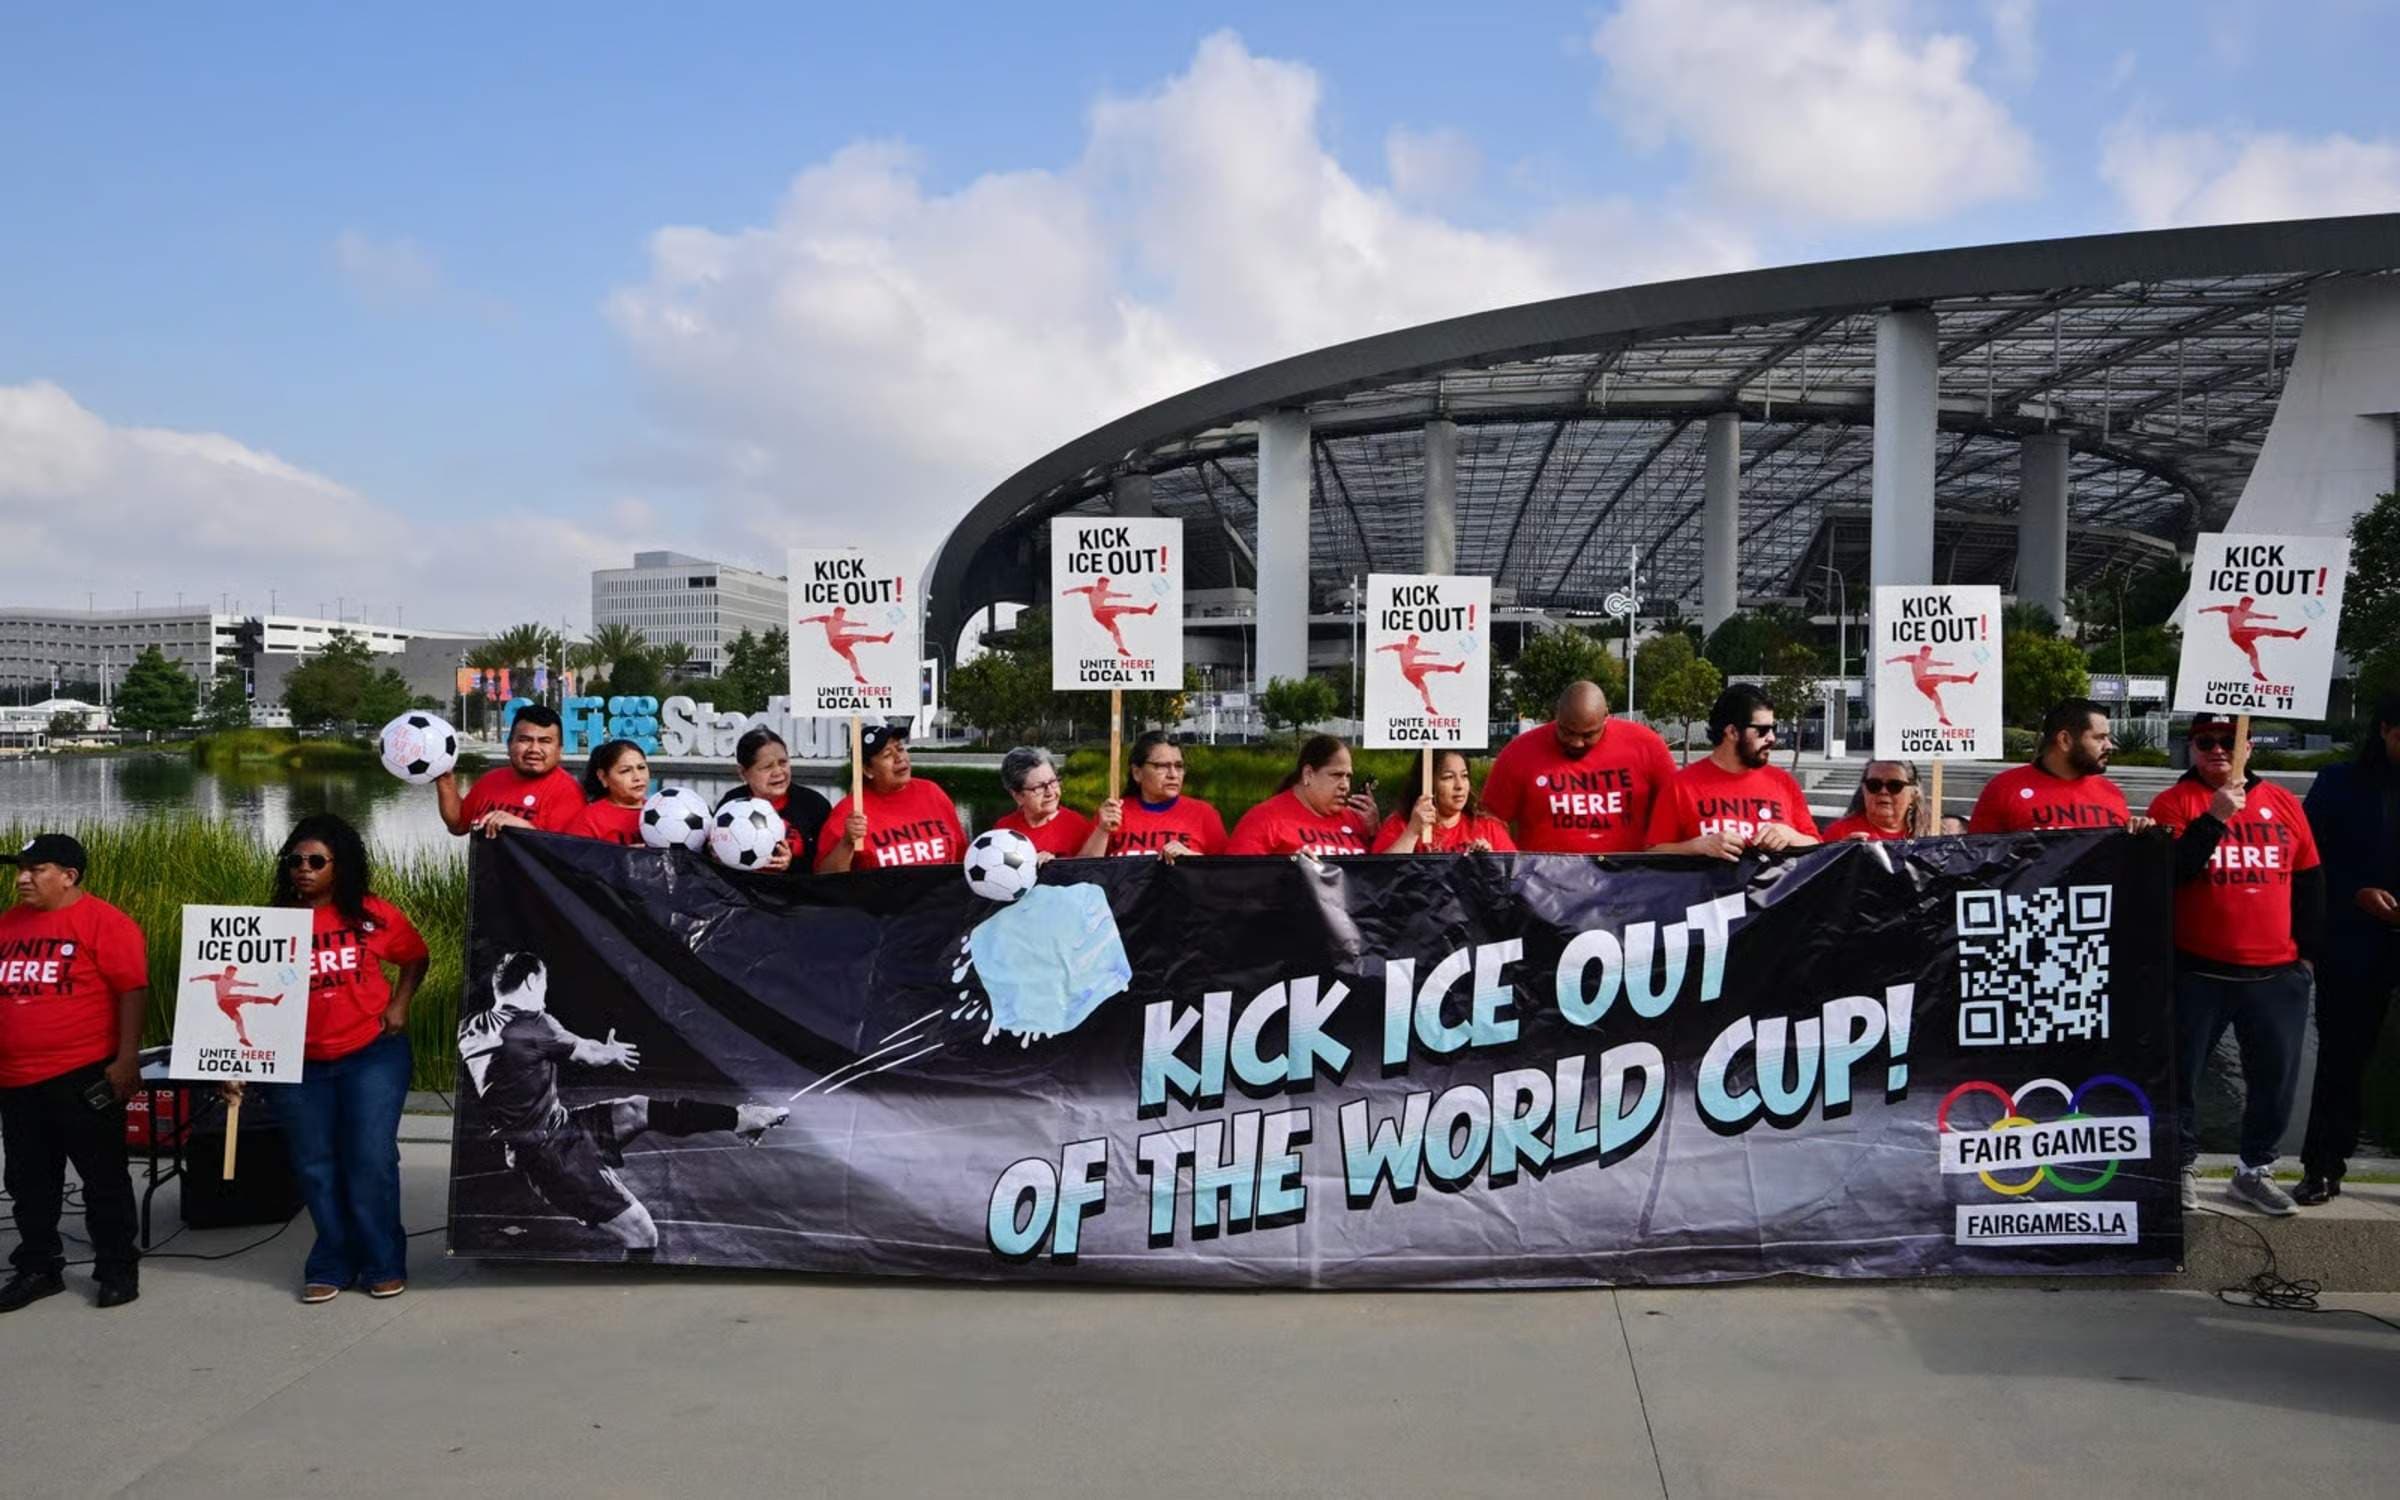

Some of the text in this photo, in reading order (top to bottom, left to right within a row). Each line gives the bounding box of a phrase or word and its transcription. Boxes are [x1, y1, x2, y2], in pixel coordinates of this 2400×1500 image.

[1079, 527, 1130, 550] KICK
[1069, 545, 1168, 575] ICE OUT!
[2225, 545, 2285, 568] KICK
[814, 558, 866, 581] KICK
[805, 576, 902, 605] ICE OUT!
[2209, 567, 2327, 596] ICE OUT!
[1392, 585, 1440, 607] KICK
[1902, 595, 1954, 618] KICK
[1382, 604, 1475, 632] ICE OUT!
[1892, 614, 1987, 643] ICE OUT!
[1080, 659, 1155, 669] UNITE HERE!
[1080, 670, 1155, 682] LOCAL 11
[817, 687, 892, 697] UNITE HERE!
[2207, 681, 2295, 696] UNITE HERE!
[817, 698, 892, 709] LOCAL 11
[2205, 692, 2294, 710] LOCAL 11
[504, 696, 605, 753] Fi
[1389, 718, 1461, 728] UNITE HERE!
[1901, 729, 1975, 739] UNITE HERE!
[1389, 729, 1461, 741] LOCAL 11
[1901, 740, 1975, 752] LOCAL 11
[1549, 768, 1632, 792] UNITE
[1698, 798, 1784, 820] UNITE
[871, 820, 950, 847] UNITE
[1553, 815, 1611, 830] LOCAL
[1700, 819, 1771, 840] HER
[2223, 822, 2288, 844] NITE
[1298, 827, 1360, 846] UNIT
[2212, 871, 2270, 885] OCAL
[210, 916, 261, 938] KICK
[198, 936, 296, 964] ICE OUT!
[1138, 891, 1747, 1115] KICK ICE OUT
[200, 1048, 276, 1061] UNITE HERE!
[198, 1059, 275, 1074] LOCAL 11
[987, 982, 1915, 1263] OF THE WORLD CUP!
[1960, 1126, 2137, 1164] FAIR GAMES
[1968, 1212, 2128, 1237] FAIRGAMES.LA
